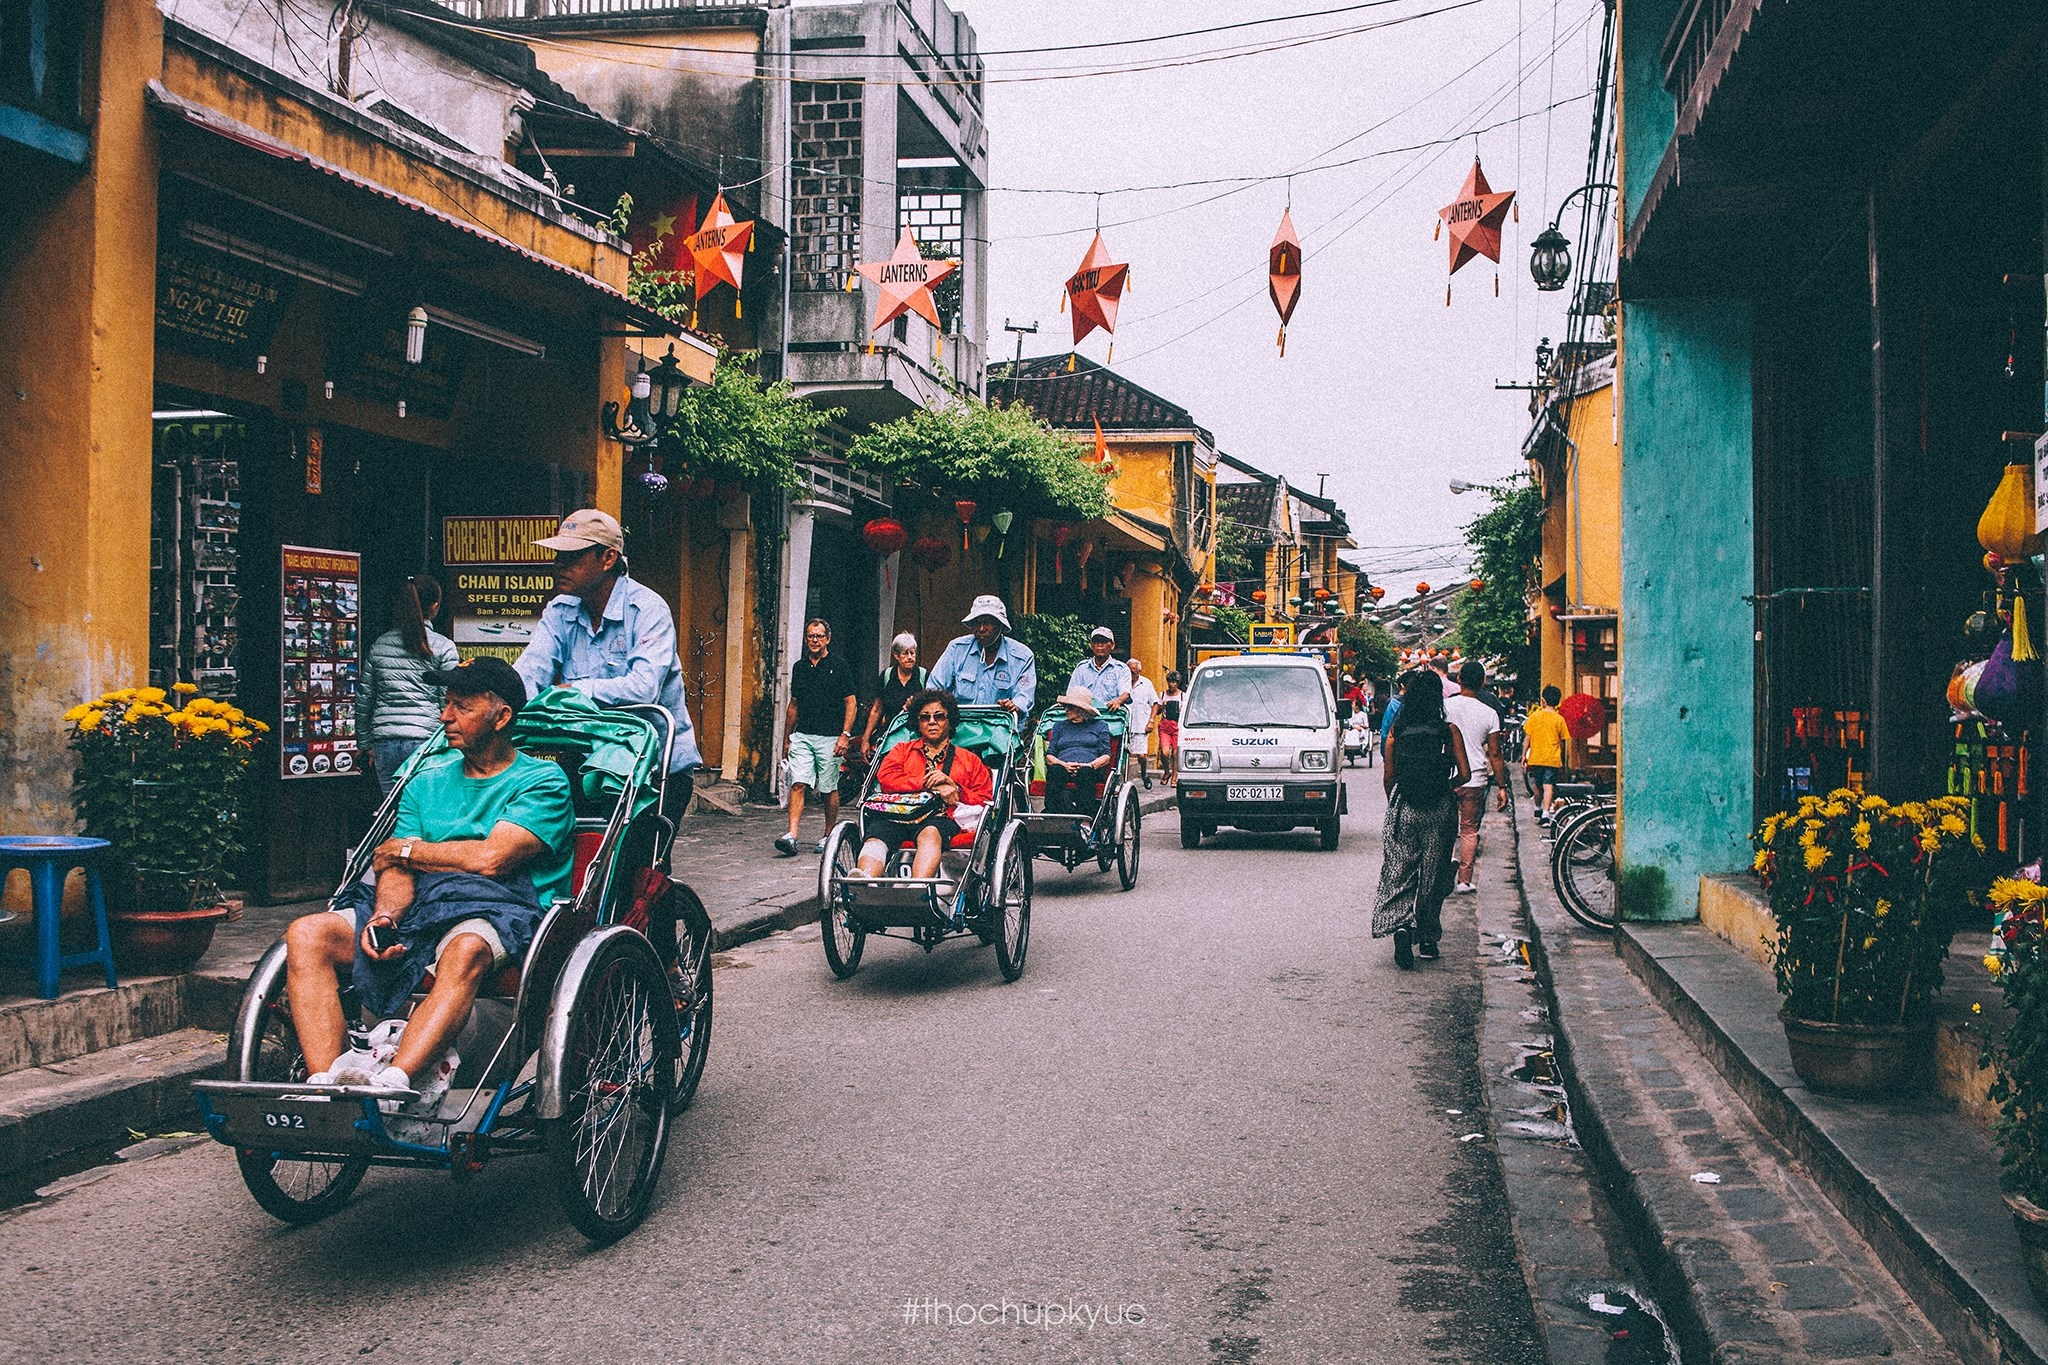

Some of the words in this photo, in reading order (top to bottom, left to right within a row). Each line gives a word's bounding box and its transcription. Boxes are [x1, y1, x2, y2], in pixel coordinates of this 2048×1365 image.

[1447, 199, 1484, 225] LANTERNS
[693, 228, 726, 252] LANTERNS
[880, 264, 928, 283] LANTERNS
[447, 520, 496, 561] FOREIGN
[499, 520, 557, 561] EXCHANGE
[458, 574, 500, 589] CHAM
[505, 575, 554, 590] ISLAND
[468, 594, 508, 603] SPEED
[512, 594, 545, 604] BOAT
[501, 608, 532, 616] 2h30pm
[1232, 738, 1278, 746] SUZUKI
[1229, 788, 1281, 799] 92C-021.12
[266, 1114, 305, 1129] 092
